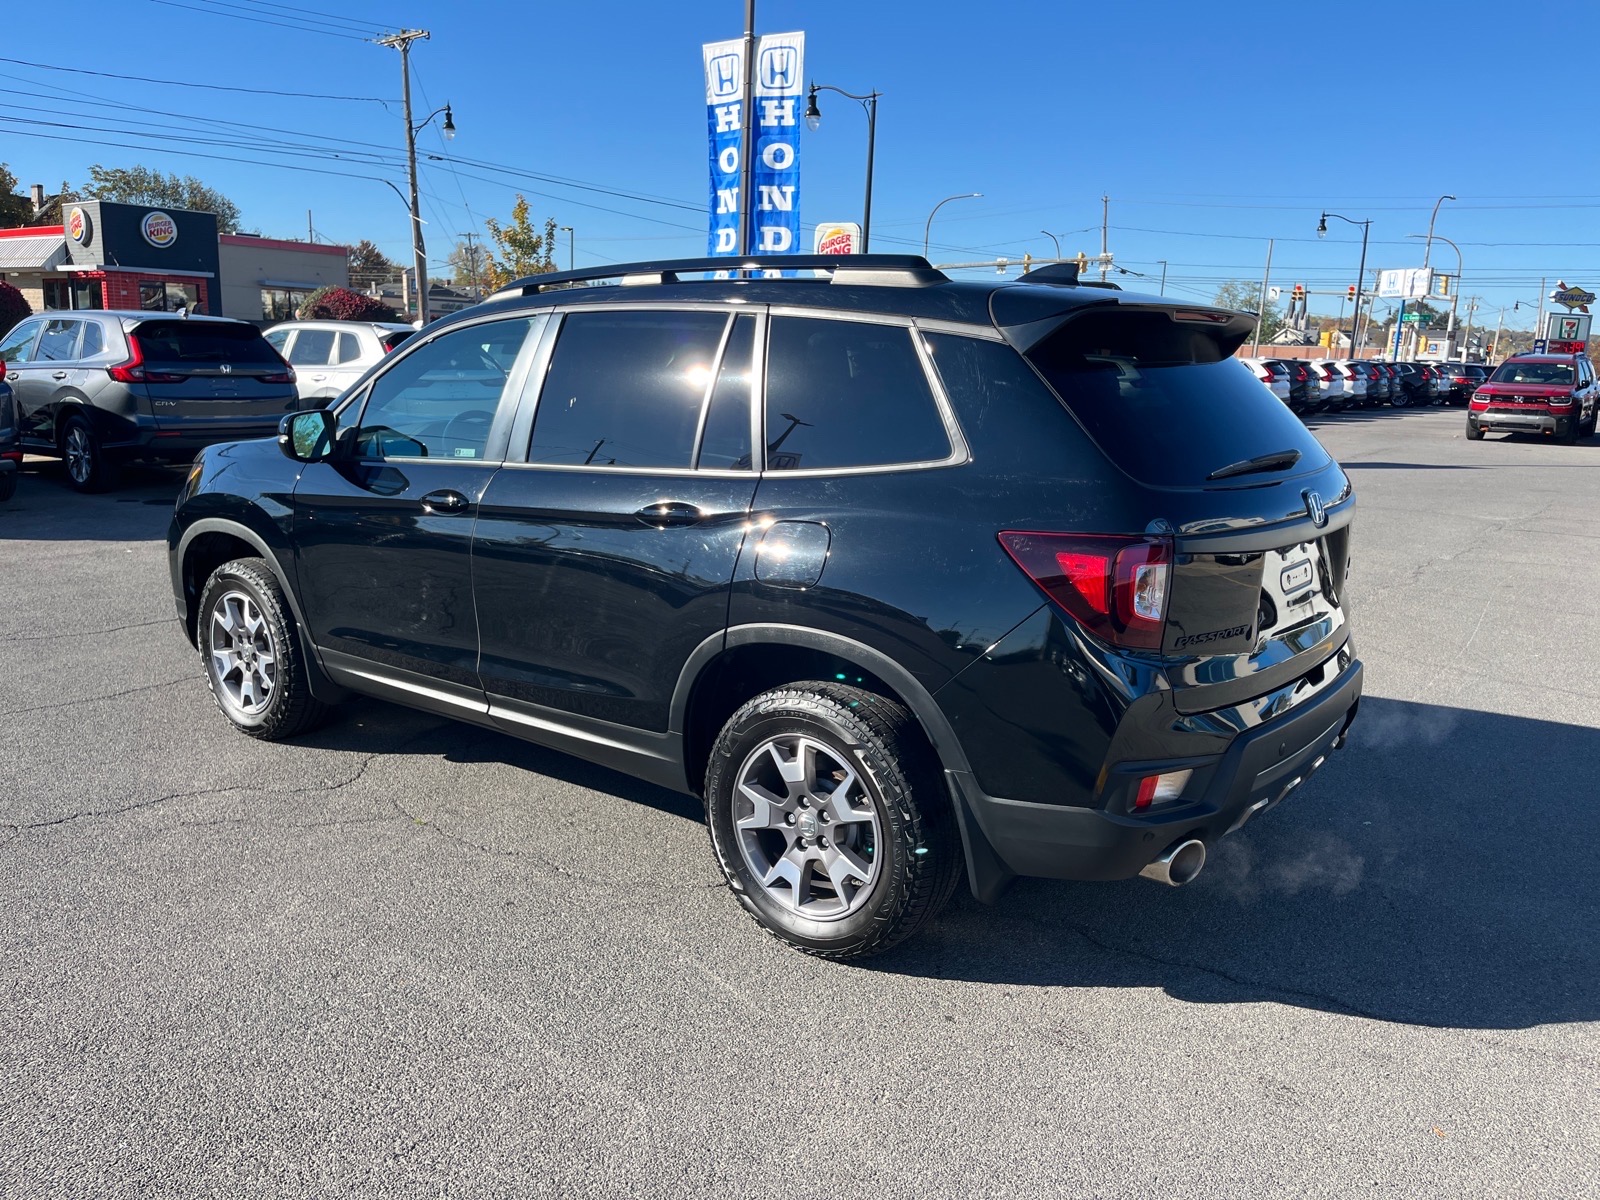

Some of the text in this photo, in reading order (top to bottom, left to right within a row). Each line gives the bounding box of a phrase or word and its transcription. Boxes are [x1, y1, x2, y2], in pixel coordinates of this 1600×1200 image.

[148, 221, 172, 229] BURGER
[149, 227, 173, 237] KING
[821, 234, 851, 252] BURGER
[1558, 293, 1593, 302] SUNOCO
[1174, 624, 1249, 647] PASSPORT
